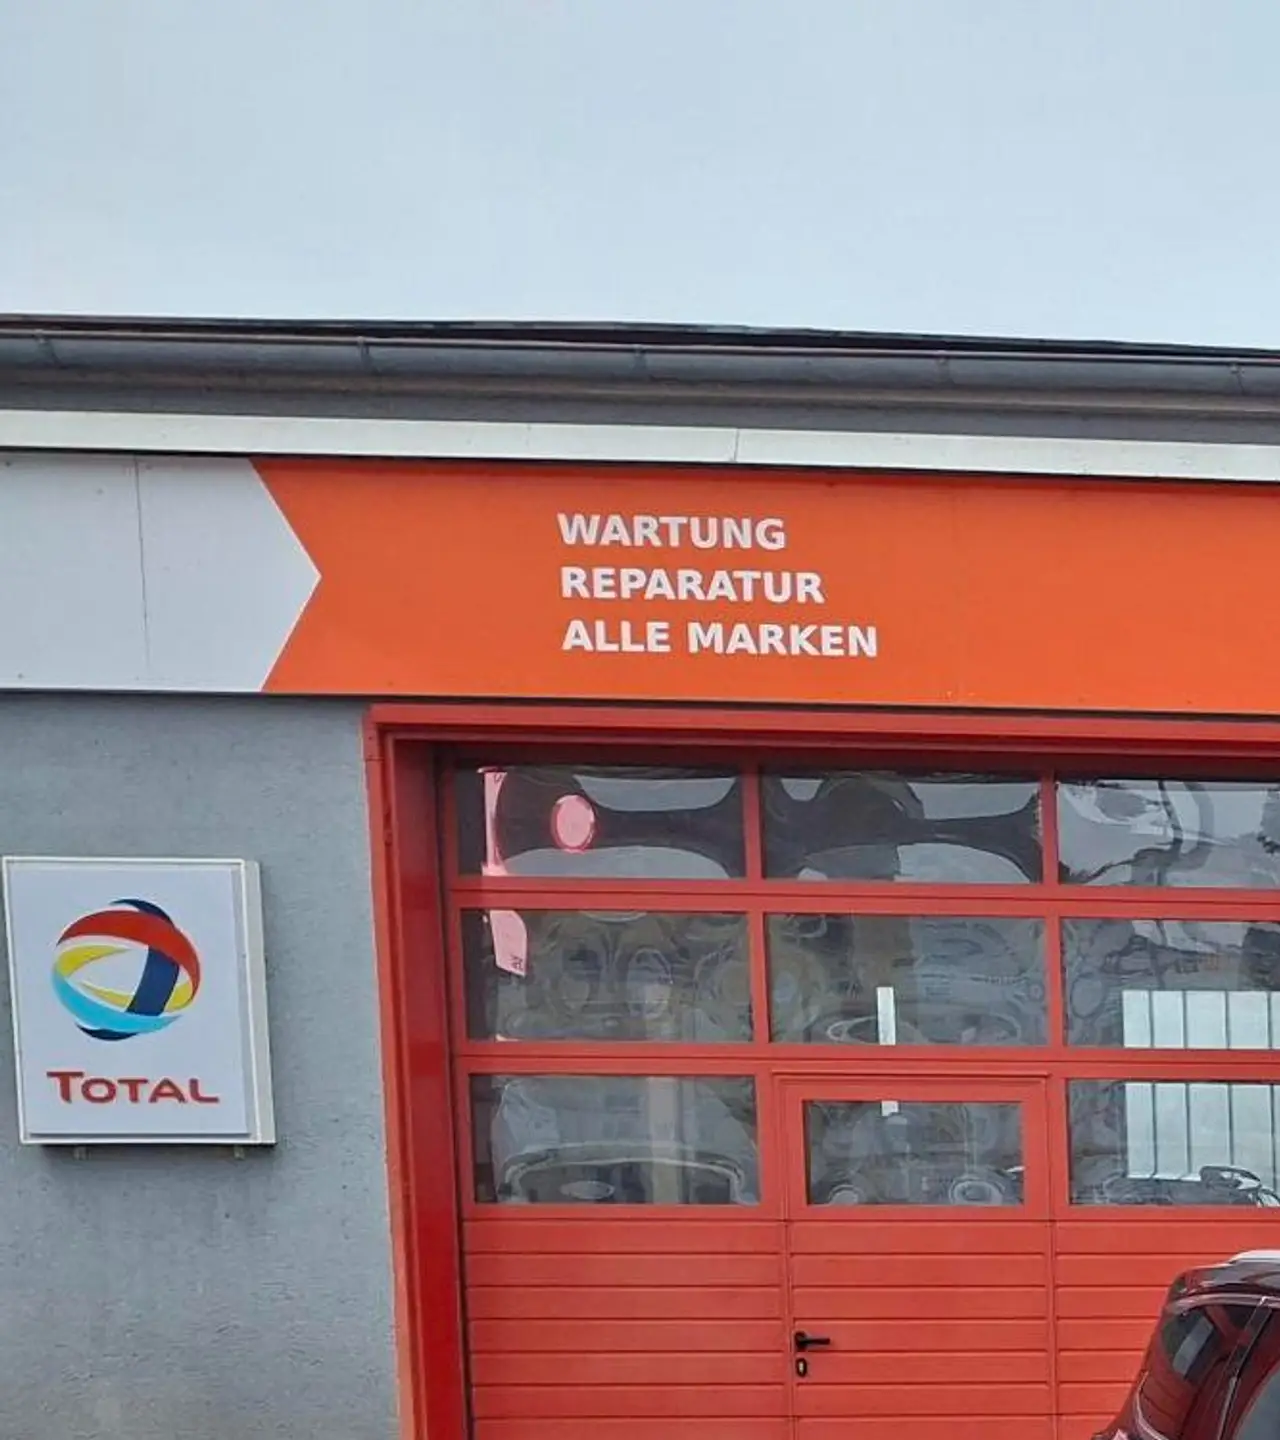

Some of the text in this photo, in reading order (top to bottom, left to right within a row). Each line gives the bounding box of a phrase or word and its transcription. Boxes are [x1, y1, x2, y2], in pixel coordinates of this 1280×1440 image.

[557, 513, 786, 550] WARTUNG
[561, 566, 826, 604] REPARATUR
[562, 620, 877, 658] ALLE MARKEN
[46, 1071, 220, 1103] TOTAL
